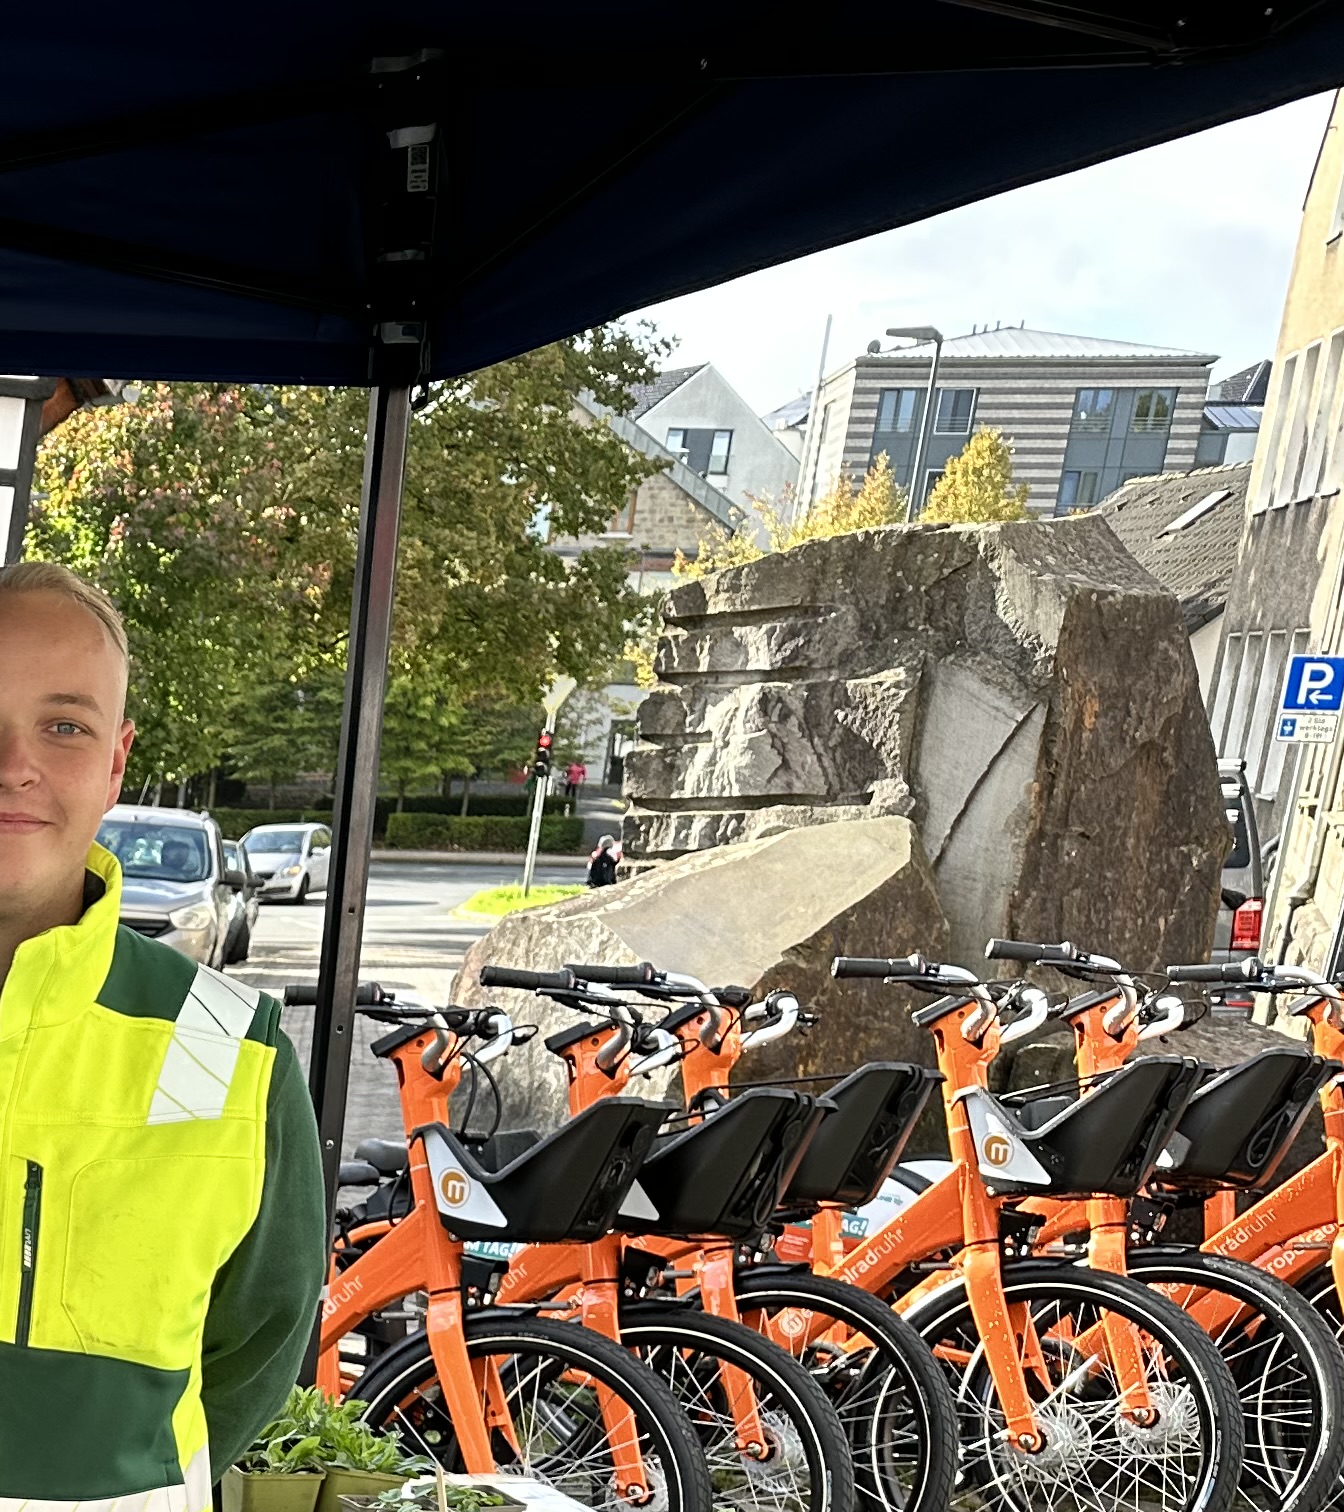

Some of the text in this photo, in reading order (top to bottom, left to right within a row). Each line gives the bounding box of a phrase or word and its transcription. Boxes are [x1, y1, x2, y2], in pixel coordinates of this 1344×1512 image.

[1297, 662, 1334, 704] P
[841, 1214, 868, 1234] AG!
[1214, 1206, 1278, 1256] lradruhr
[838, 1227, 905, 1285] olradruhr
